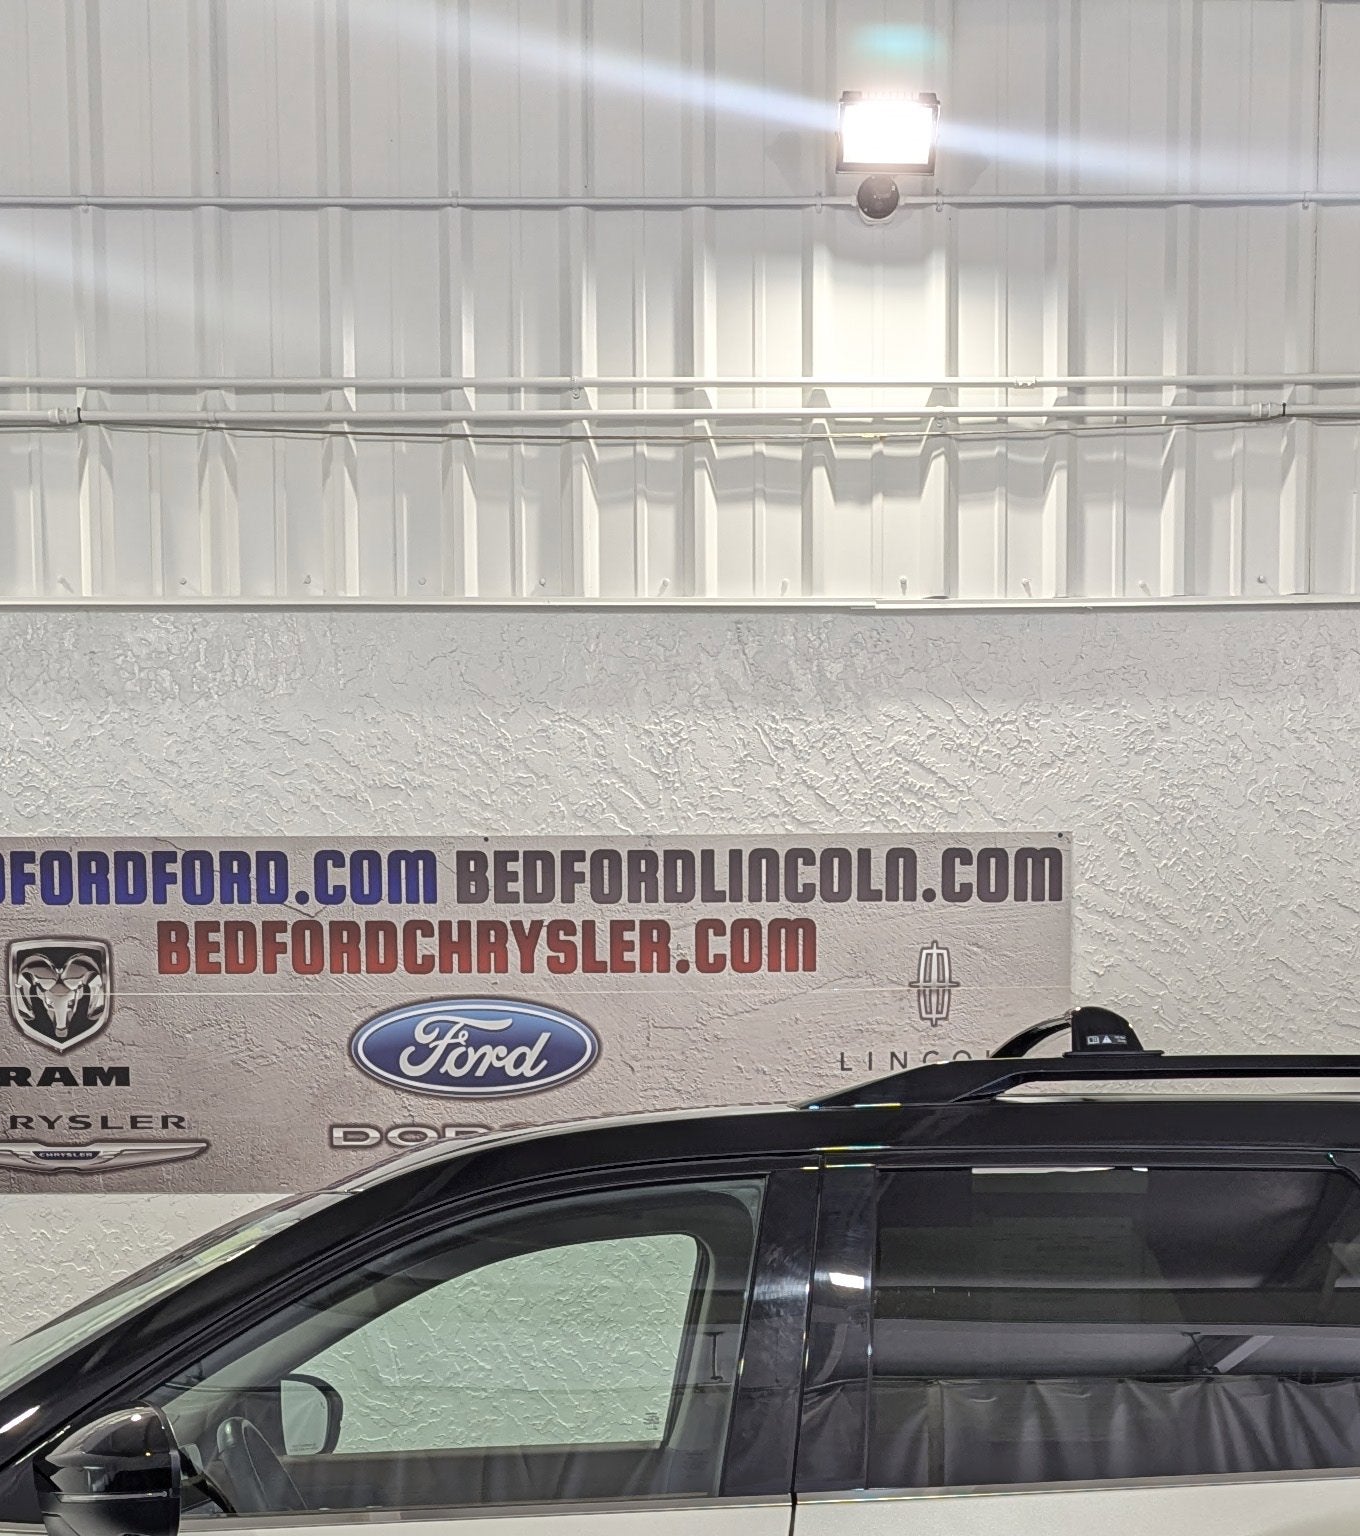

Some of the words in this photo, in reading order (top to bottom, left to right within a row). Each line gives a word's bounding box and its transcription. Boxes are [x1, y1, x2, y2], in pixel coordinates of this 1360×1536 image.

[454, 846, 1064, 905] BEDFORDLINCOLN.COM
[156, 917, 818, 975] BEDFORDCHRYSLER.COM
[399, 1015, 551, 1077] Ford
